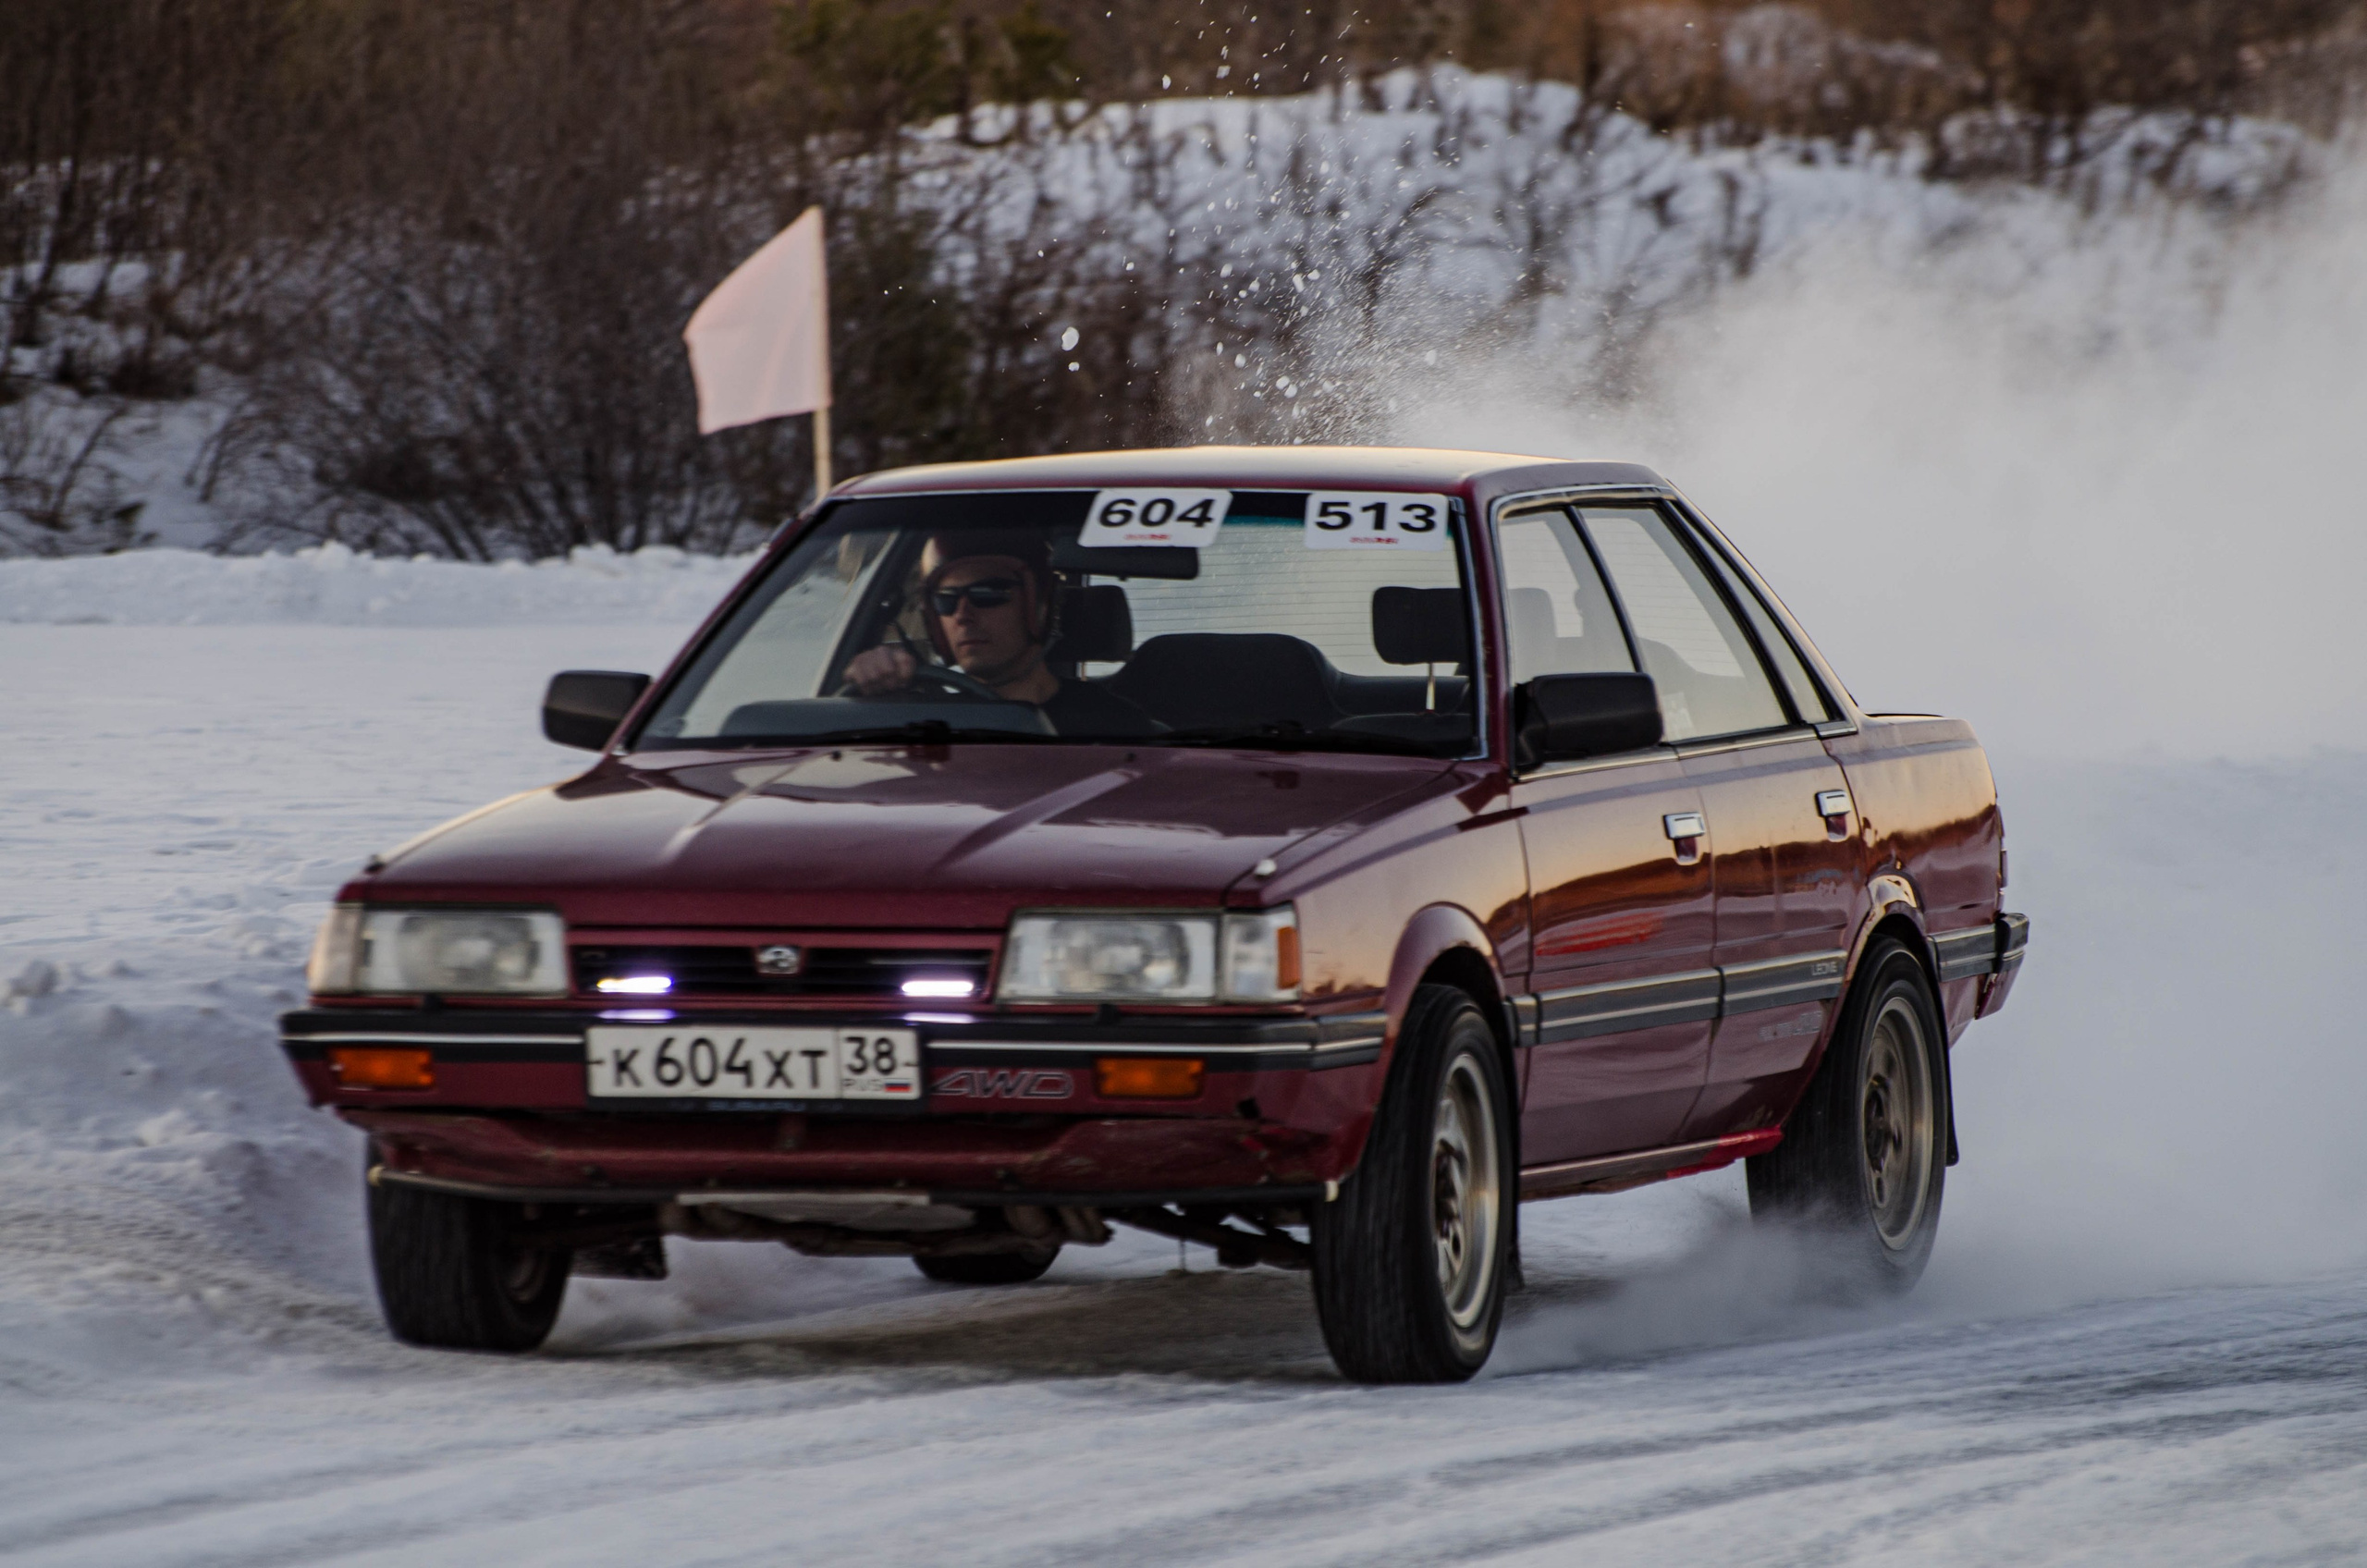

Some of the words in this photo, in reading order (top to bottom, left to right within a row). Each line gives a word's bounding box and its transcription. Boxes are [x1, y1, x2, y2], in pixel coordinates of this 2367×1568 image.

[1098, 498, 1214, 527] 604
[1315, 501, 1437, 533] 513
[613, 1037, 827, 1088] K604XT
[844, 1036, 898, 1075] 38
